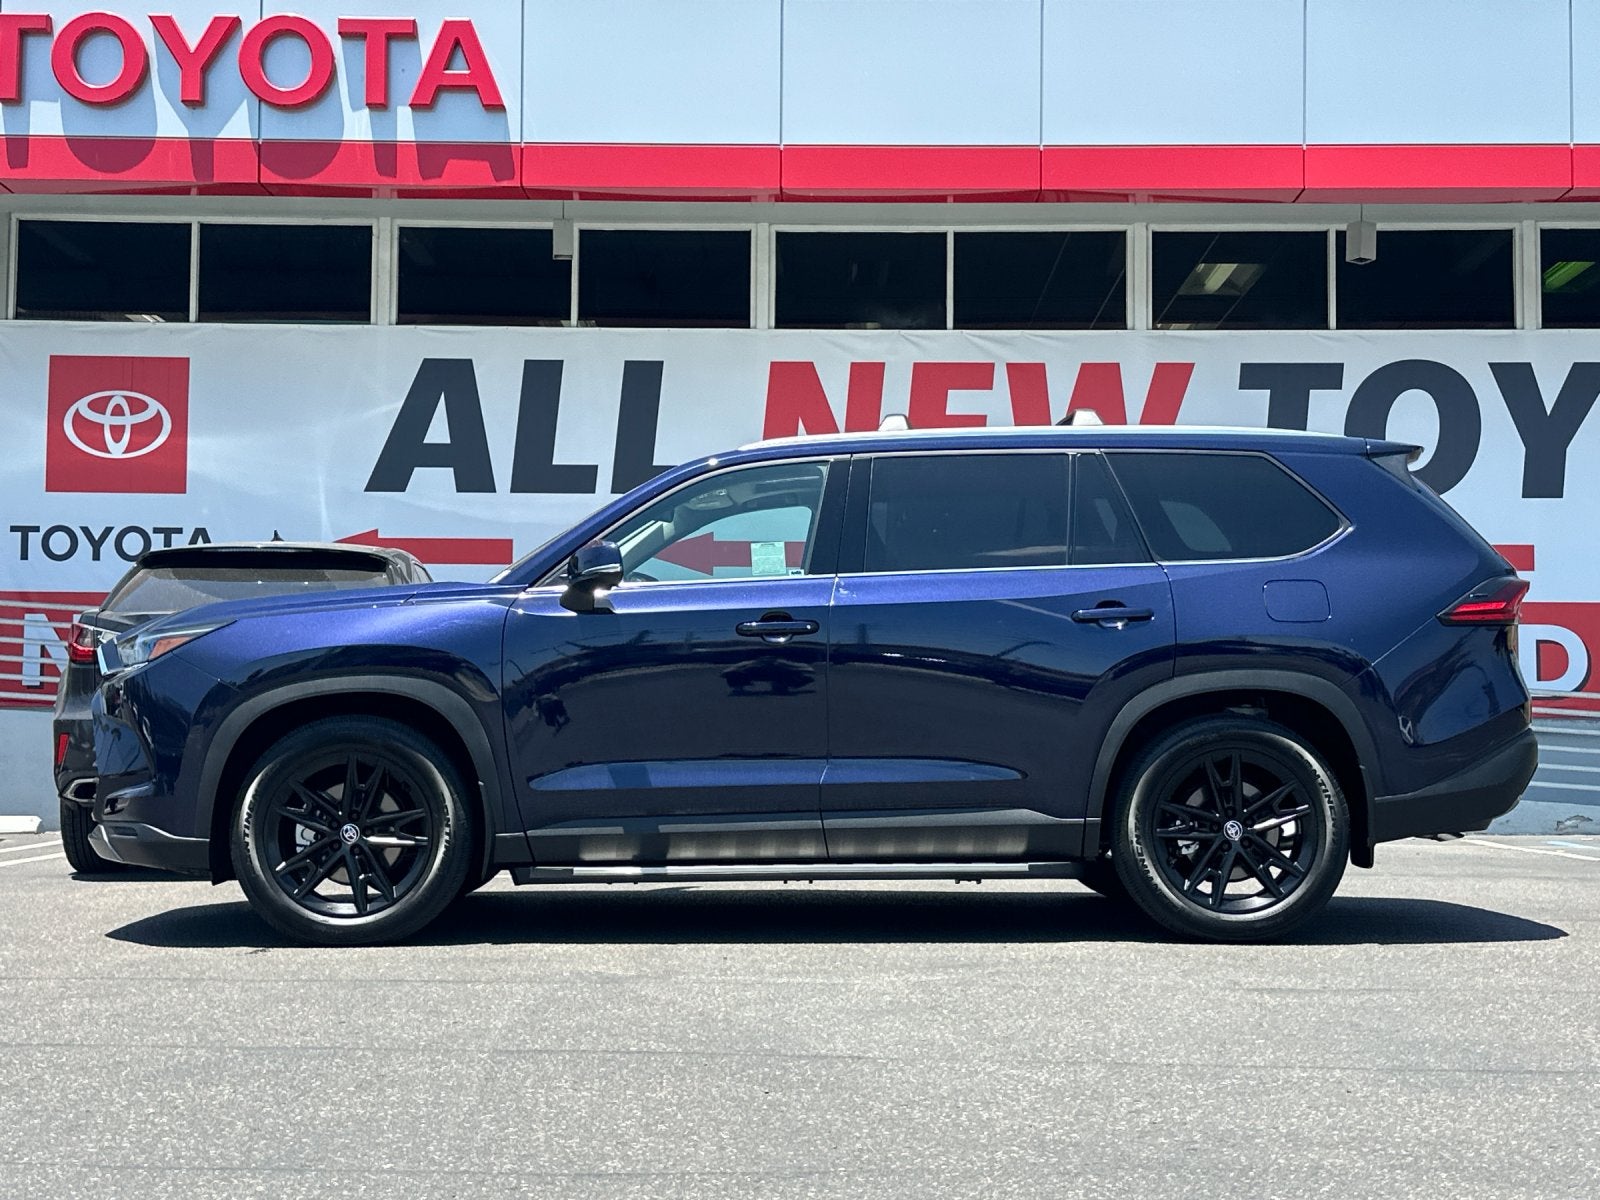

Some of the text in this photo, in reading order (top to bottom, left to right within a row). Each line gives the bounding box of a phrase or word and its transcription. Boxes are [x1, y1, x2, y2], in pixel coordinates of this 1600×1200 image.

[0, 12, 506, 109] TOYOTA
[364, 358, 681, 494] ALL
[1239, 358, 1600, 498] TOY
